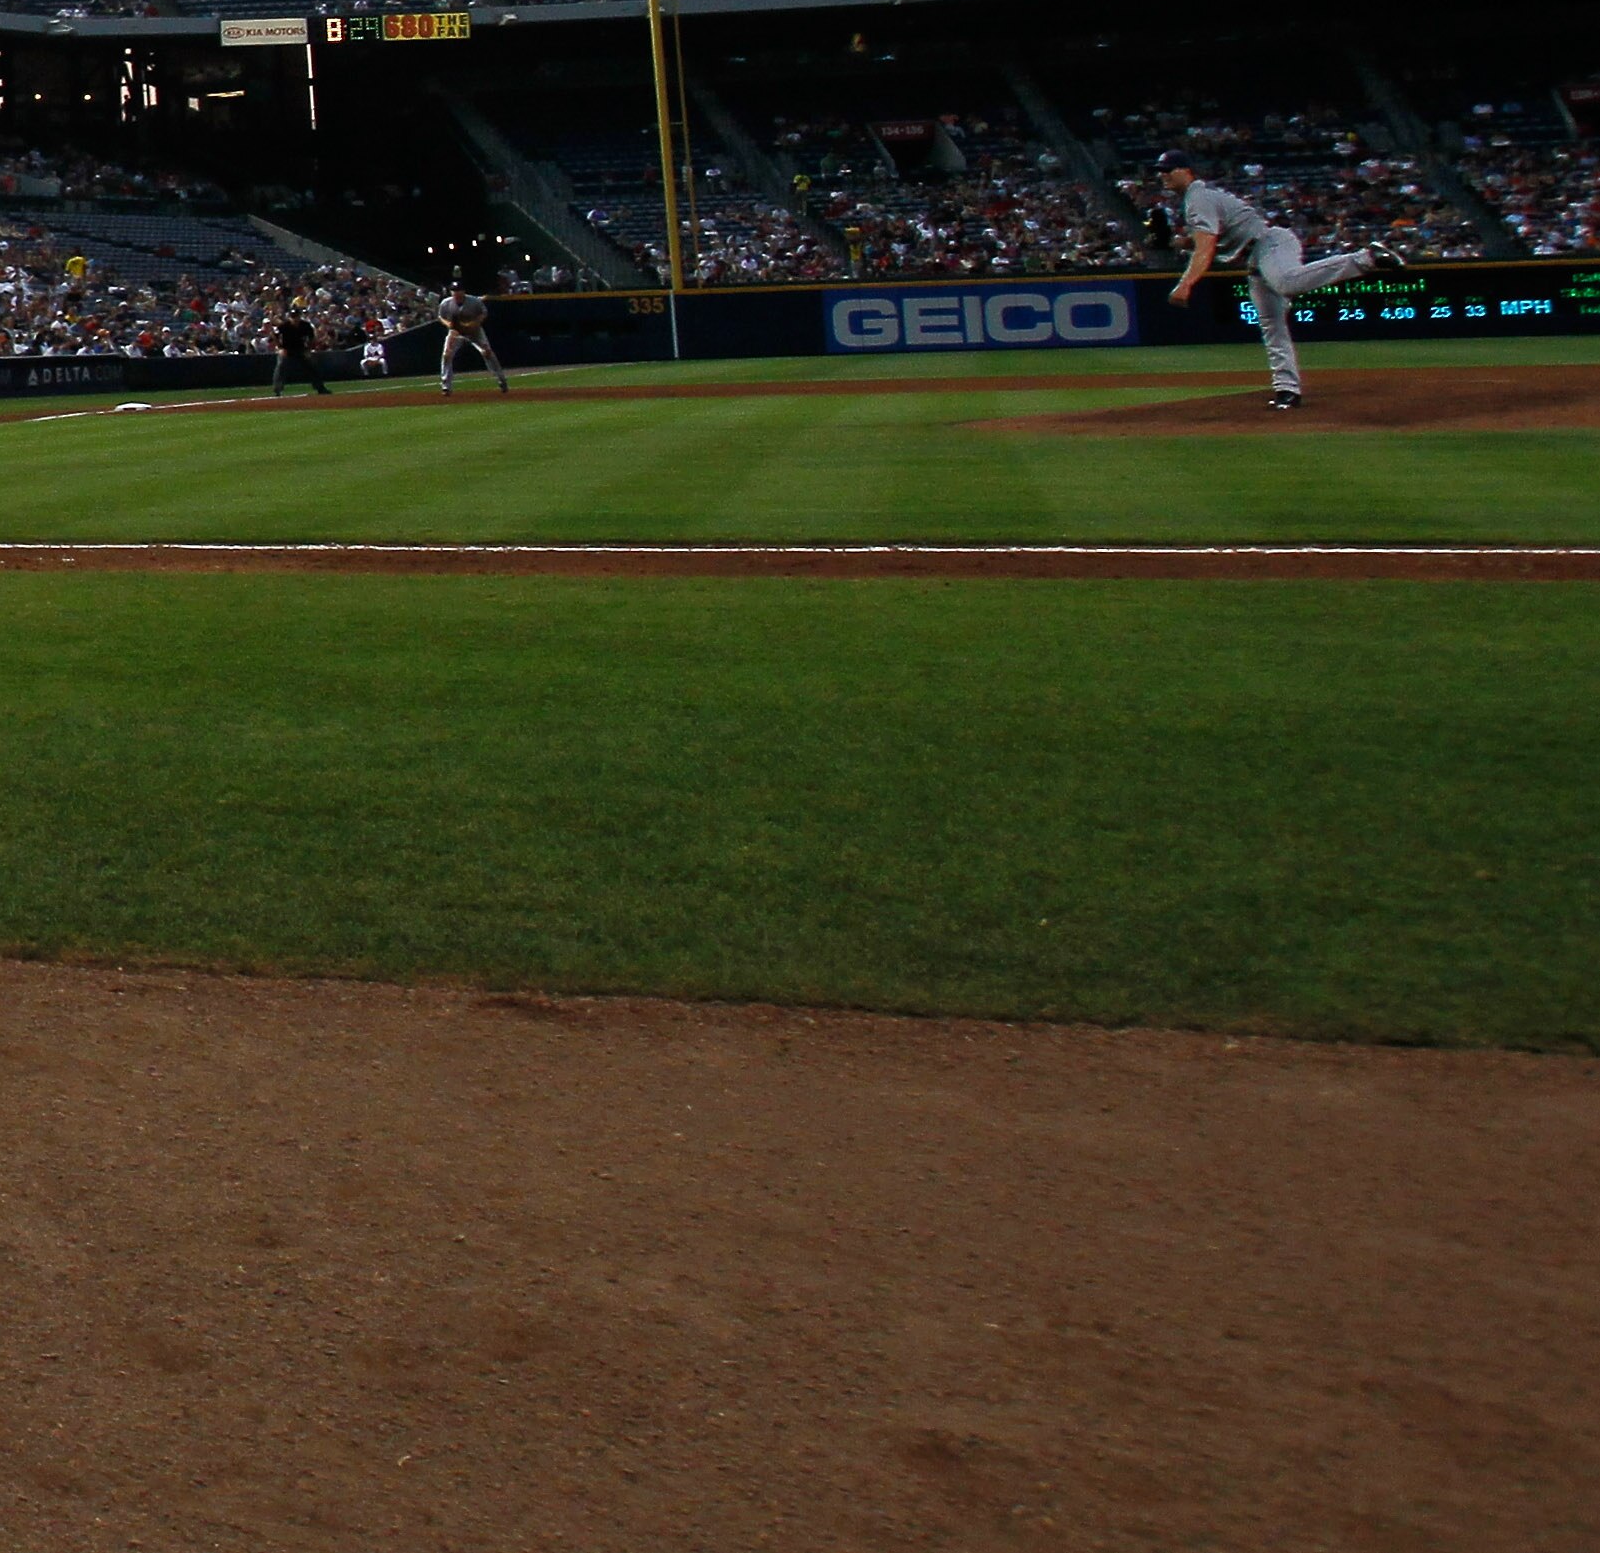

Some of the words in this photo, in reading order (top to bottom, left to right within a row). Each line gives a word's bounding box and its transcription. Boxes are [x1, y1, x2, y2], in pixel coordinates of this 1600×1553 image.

[265, 26, 306, 36] MOTORS
[384, 14, 435, 39] 680
[435, 14, 468, 27] THE
[435, 26, 468, 39] FAN
[628, 298, 665, 316] 335
[1294, 309, 1314, 323] 12
[1339, 308, 1367, 321] 2-5
[1430, 305, 1452, 319] 25
[1464, 304, 1487, 318] 33
[1499, 299, 1552, 315] MPH
[831, 290, 1131, 348] GEICO
